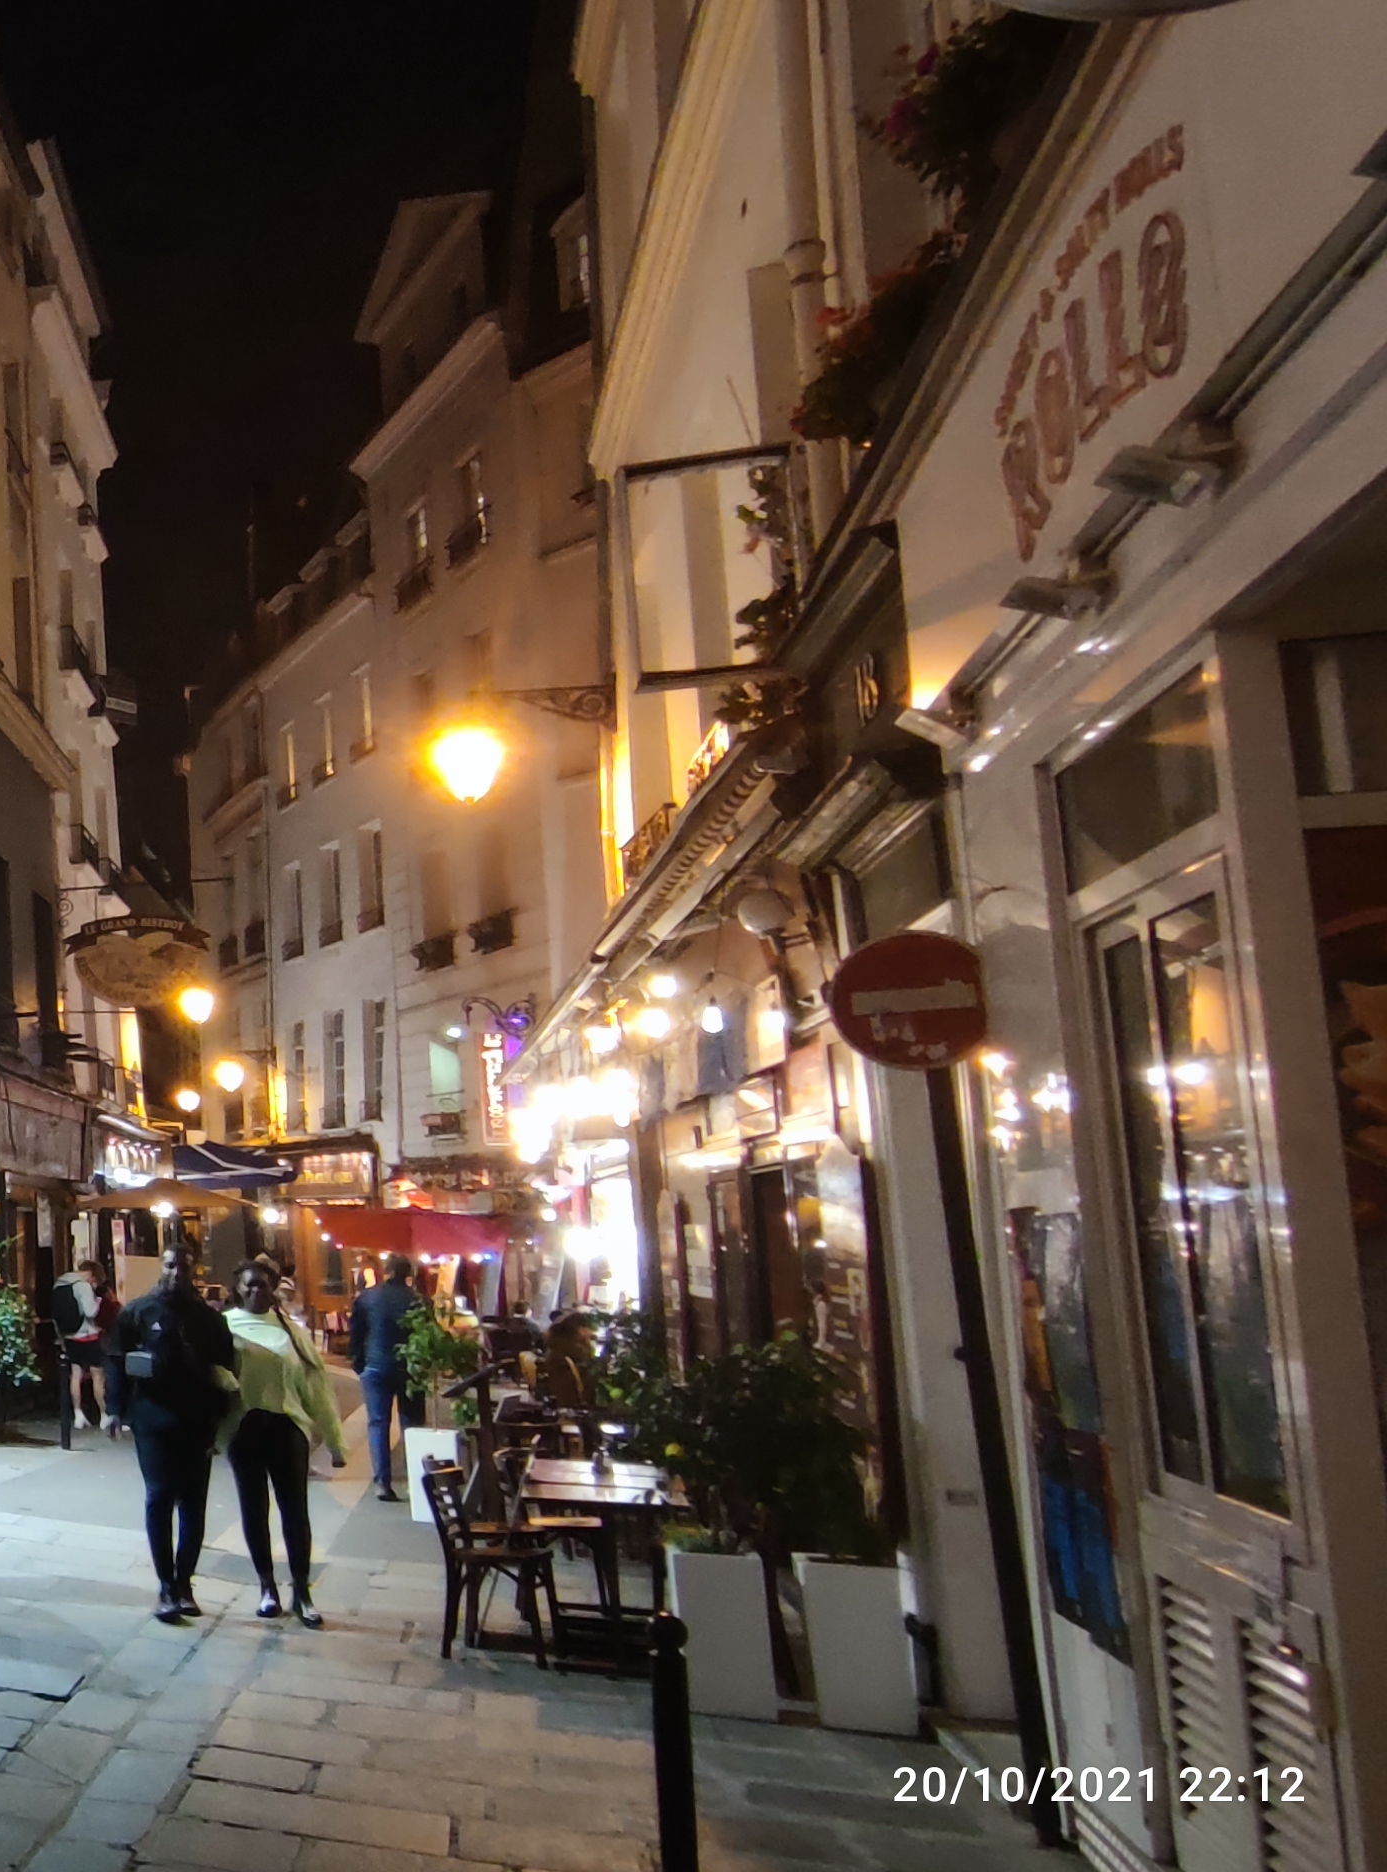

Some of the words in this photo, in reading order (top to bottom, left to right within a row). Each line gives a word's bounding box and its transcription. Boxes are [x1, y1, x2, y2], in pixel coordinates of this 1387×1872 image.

[84, 924, 97, 936] LE
[100, 918, 137, 931] GRAND
[140, 917, 186, 931] BISTROT
